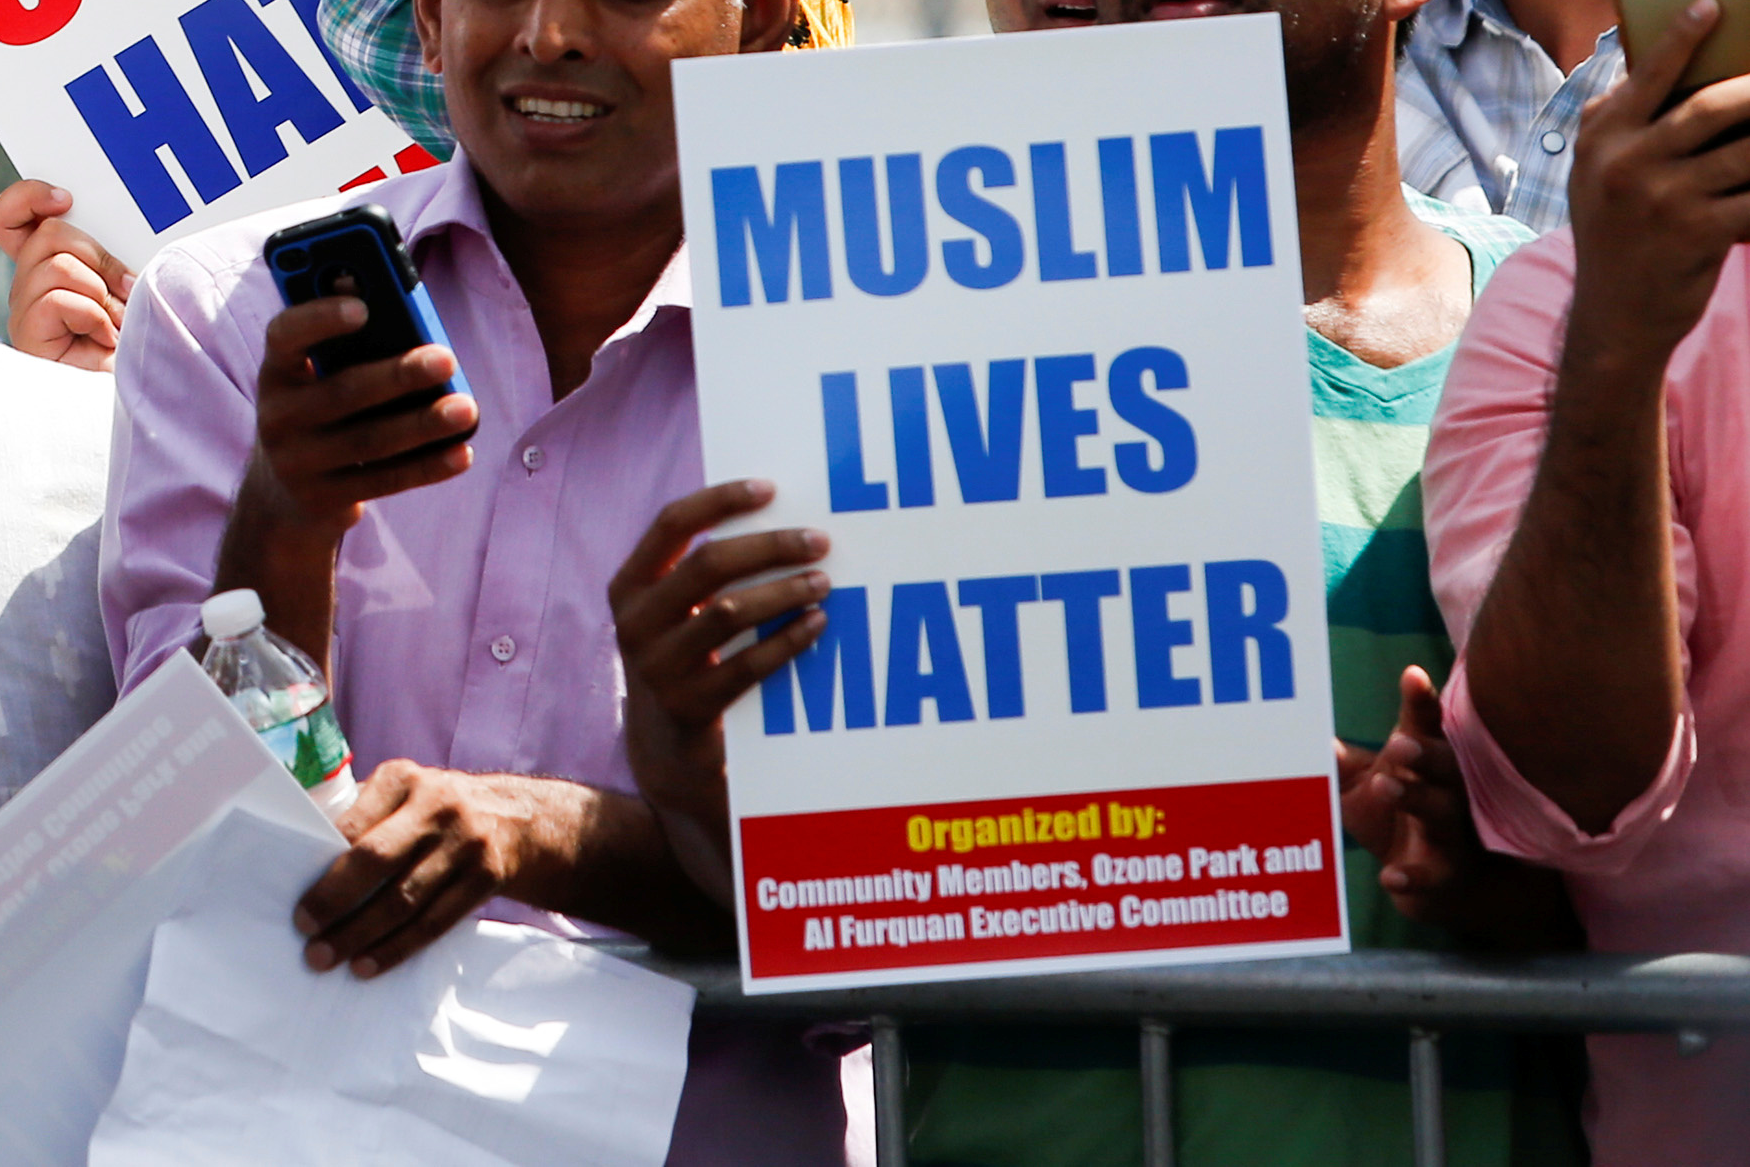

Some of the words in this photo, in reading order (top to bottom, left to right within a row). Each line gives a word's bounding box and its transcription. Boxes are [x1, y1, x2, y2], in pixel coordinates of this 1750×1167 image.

[710, 125, 1274, 307] MUSLIM
[821, 346, 1198, 513] LIVES
[757, 559, 1296, 736] MATTER
[758, 869, 931, 910] Community
[938, 861, 1087, 896] Members,
[1093, 854, 1183, 885] Ozone
[1190, 845, 1259, 878] Park
[1265, 840, 1322, 873] and
[908, 805, 1100, 851] Organized
[1109, 803, 1165, 838] by:
[805, 918, 834, 950] Al
[840, 913, 964, 947] Furquan
[970, 900, 1114, 938] Executive
[1121, 890, 1288, 927] Committee
